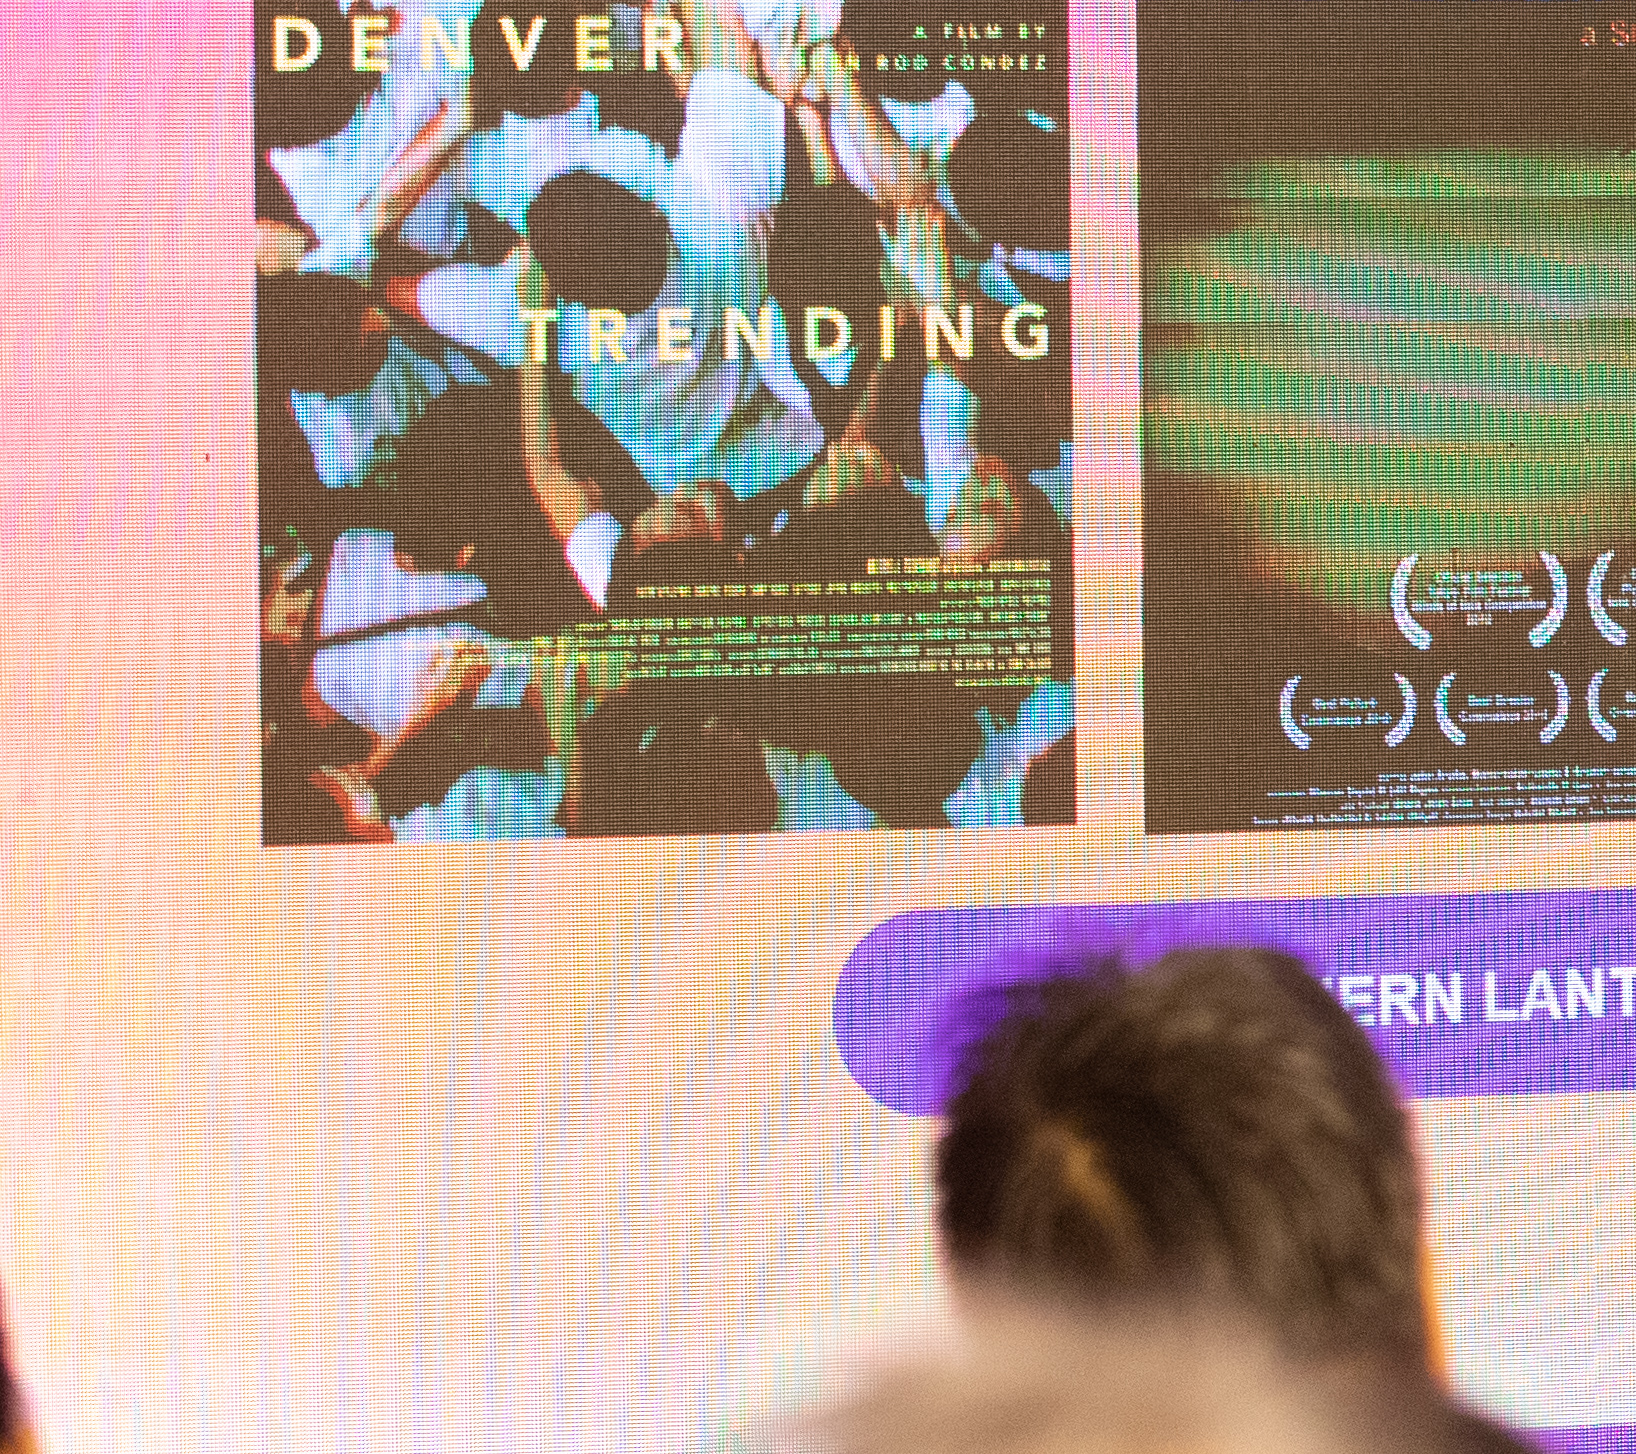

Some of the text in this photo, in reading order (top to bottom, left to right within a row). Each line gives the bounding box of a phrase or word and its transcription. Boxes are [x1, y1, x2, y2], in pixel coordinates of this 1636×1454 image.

[272, 15, 688, 73] DENVER
[521, 305, 1052, 364] TRENDING
[1338, 972, 1463, 1026] ERN
